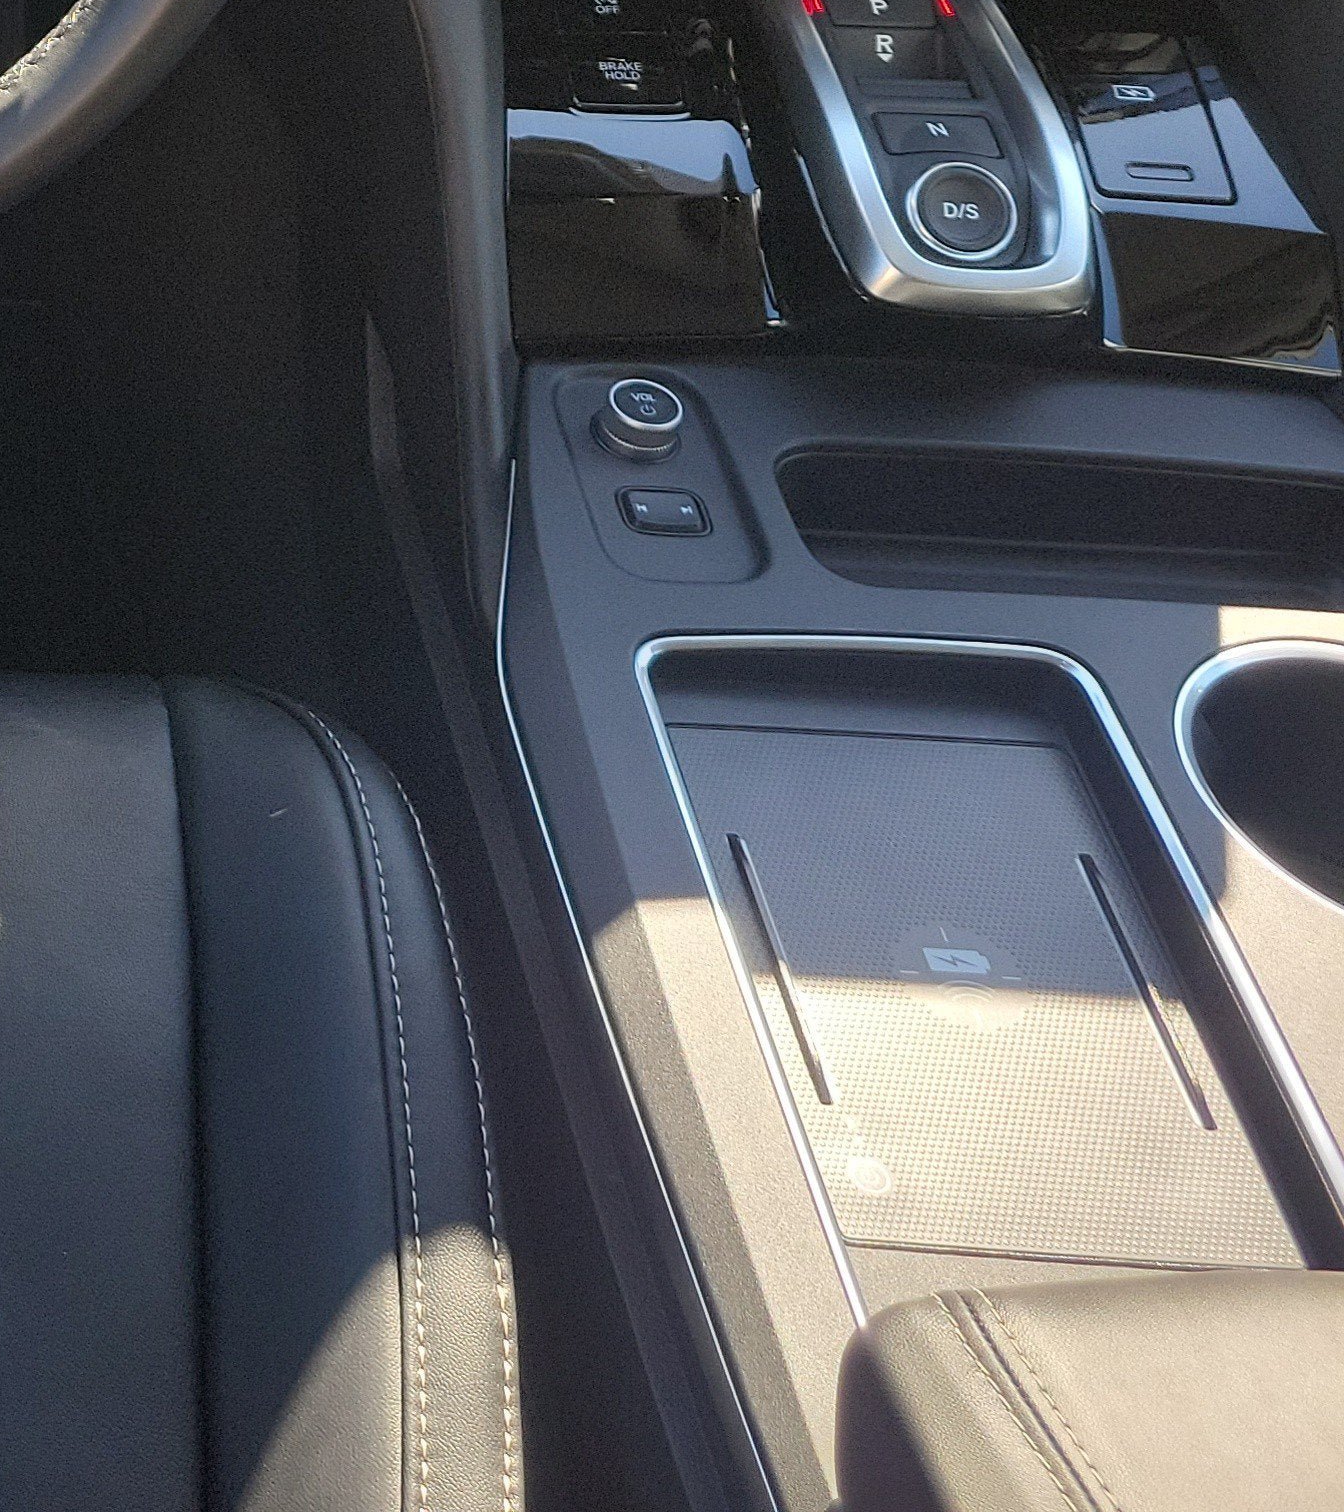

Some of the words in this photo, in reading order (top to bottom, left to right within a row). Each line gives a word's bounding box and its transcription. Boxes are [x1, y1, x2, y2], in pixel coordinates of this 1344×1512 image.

[595, 5, 621, 15] OFF
[876, 34, 894, 54] R
[598, 61, 643, 72] BRAKE
[604, 70, 641, 81] HOLD
[926, 121, 950, 139] N
[942, 200, 980, 221] D/S
[630, 391, 657, 403] VOL
